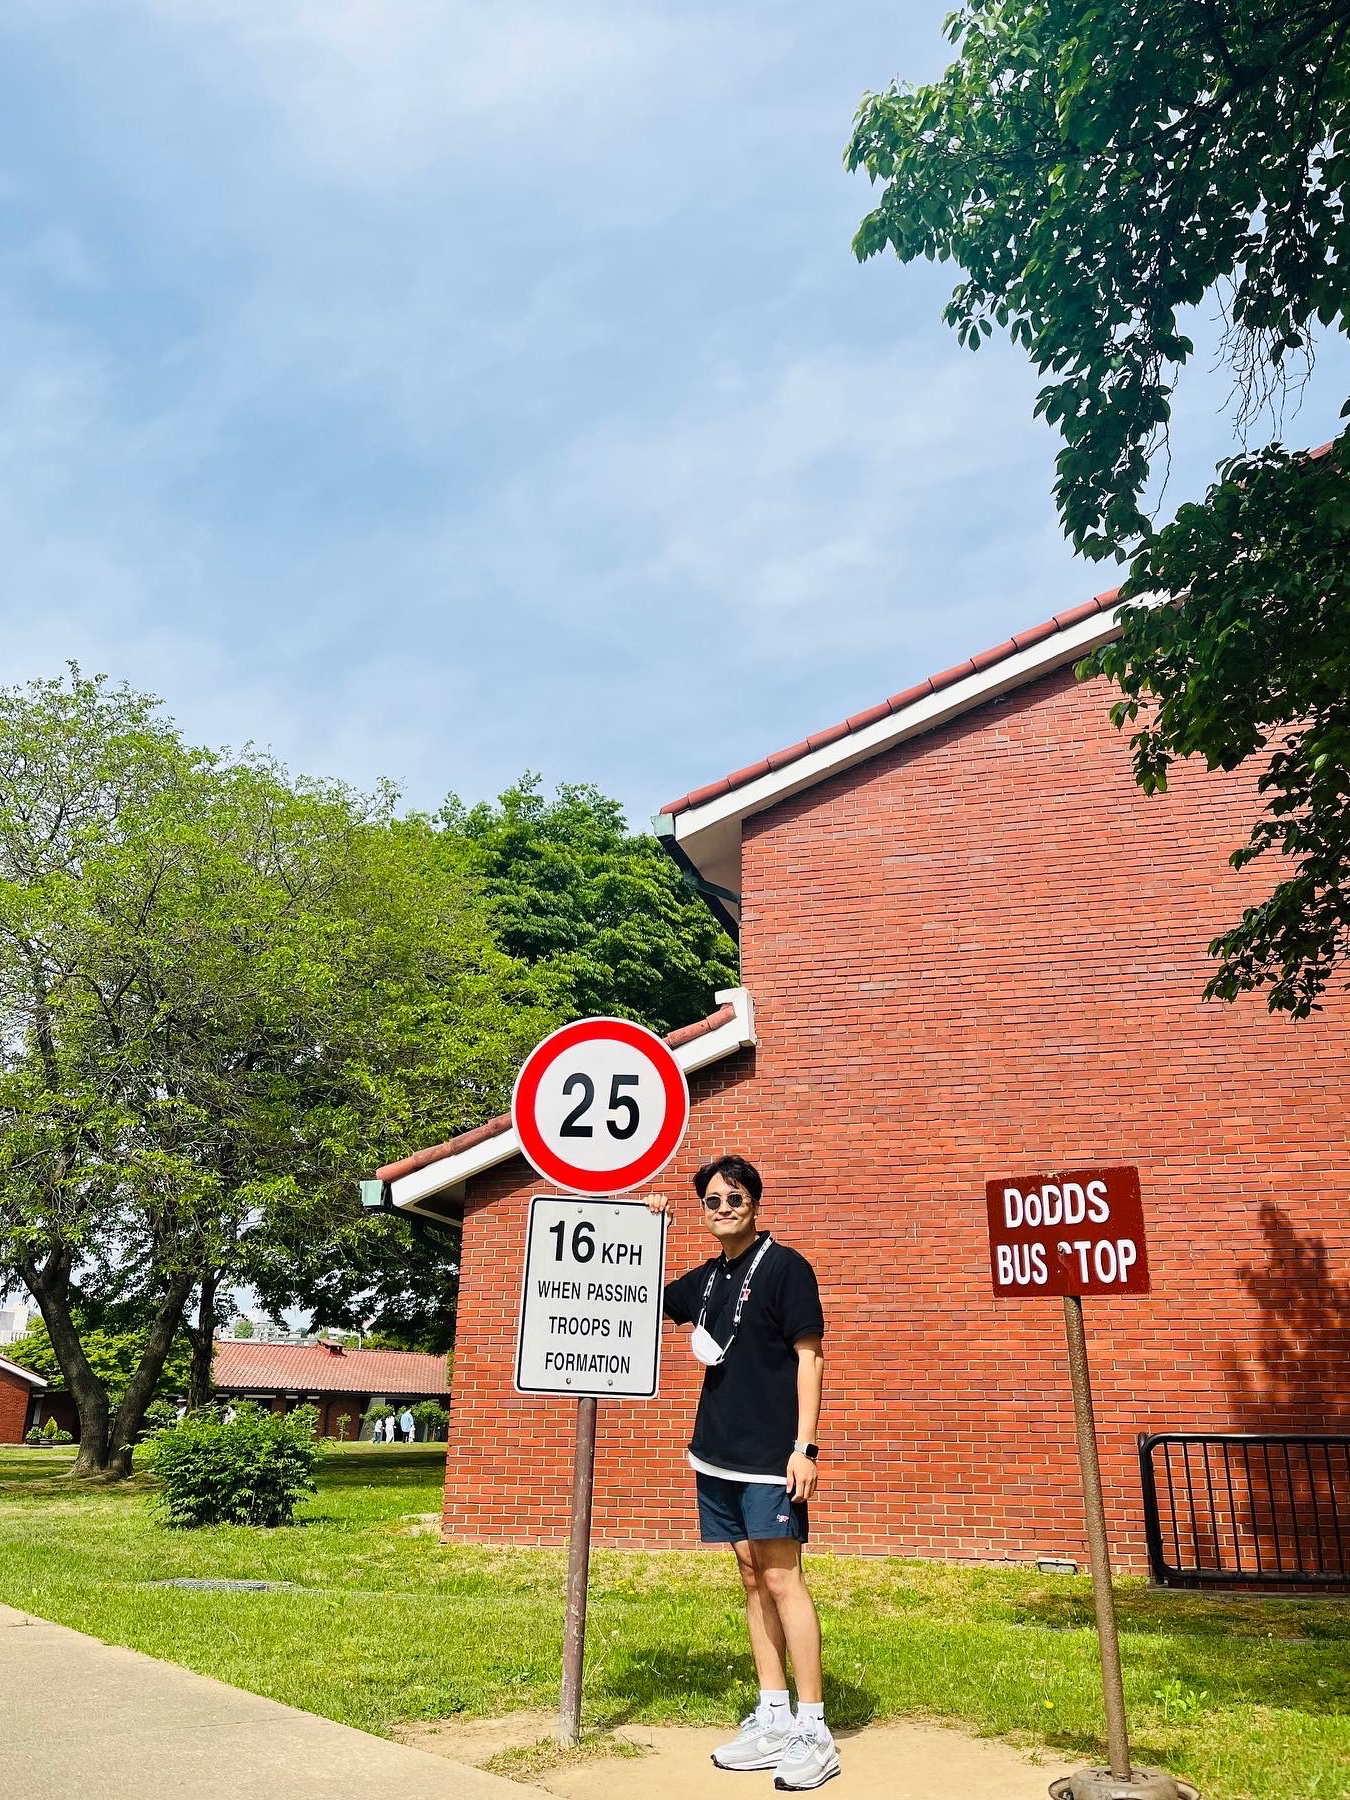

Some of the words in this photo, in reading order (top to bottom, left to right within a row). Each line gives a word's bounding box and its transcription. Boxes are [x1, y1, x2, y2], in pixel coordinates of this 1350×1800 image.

[560, 1072, 640, 1140] 25
[1004, 1180, 1110, 1228] DoDDS
[549, 1220, 596, 1264] 16
[601, 1242, 643, 1266] KPH
[996, 1242, 1048, 1285] BUS
[538, 1280, 581, 1300] WHEN
[587, 1283, 648, 1303] PASSING
[549, 1316, 610, 1337] TROOPS
[618, 1320, 632, 1338] IN
[545, 1352, 631, 1374] FORMATION
